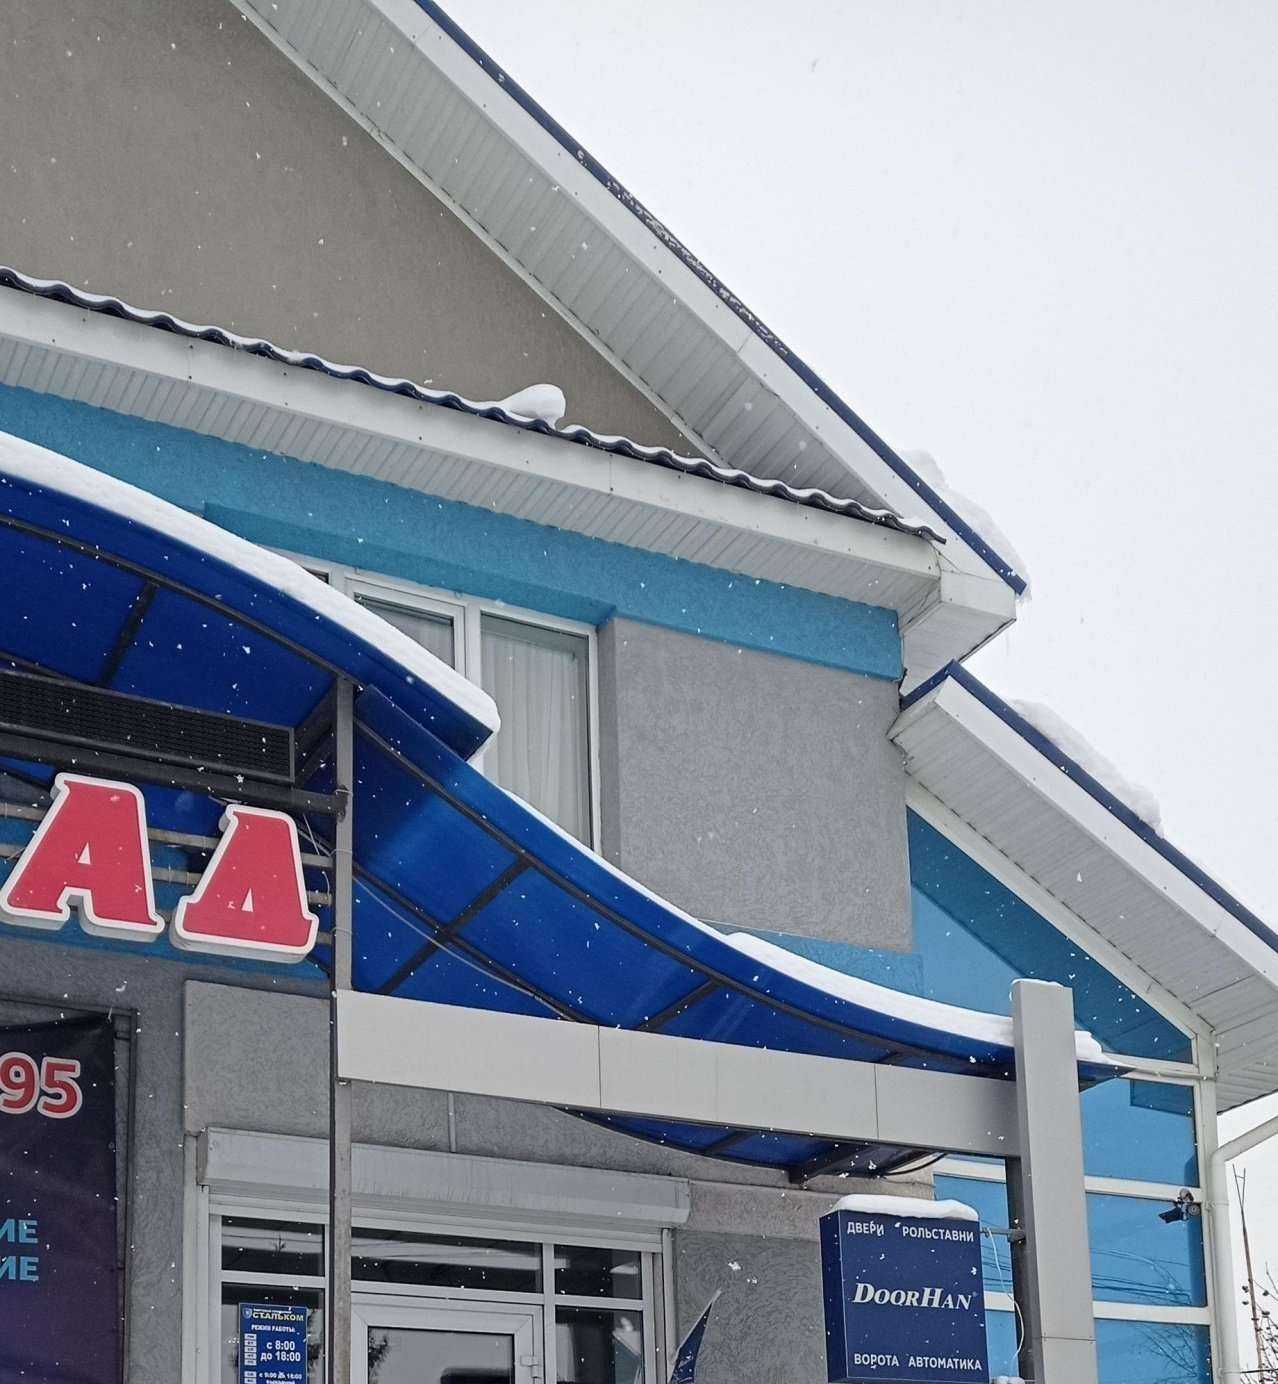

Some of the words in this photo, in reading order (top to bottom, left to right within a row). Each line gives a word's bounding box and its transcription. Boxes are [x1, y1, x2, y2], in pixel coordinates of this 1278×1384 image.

[0, 1053, 82, 1118] 95
[847, 1222, 884, 1236] ДВЕРИ
[902, 1226, 974, 1242] РОЛЬСТАВНИ
[275, 1340, 295, 1351] 8:00
[260, 1352, 273, 1362] до
[275, 1350, 301, 1362] 18:00
[854, 1353, 899, 1367] ВОРОТА
[908, 1356, 982, 1371] АВТОМАТИКА
